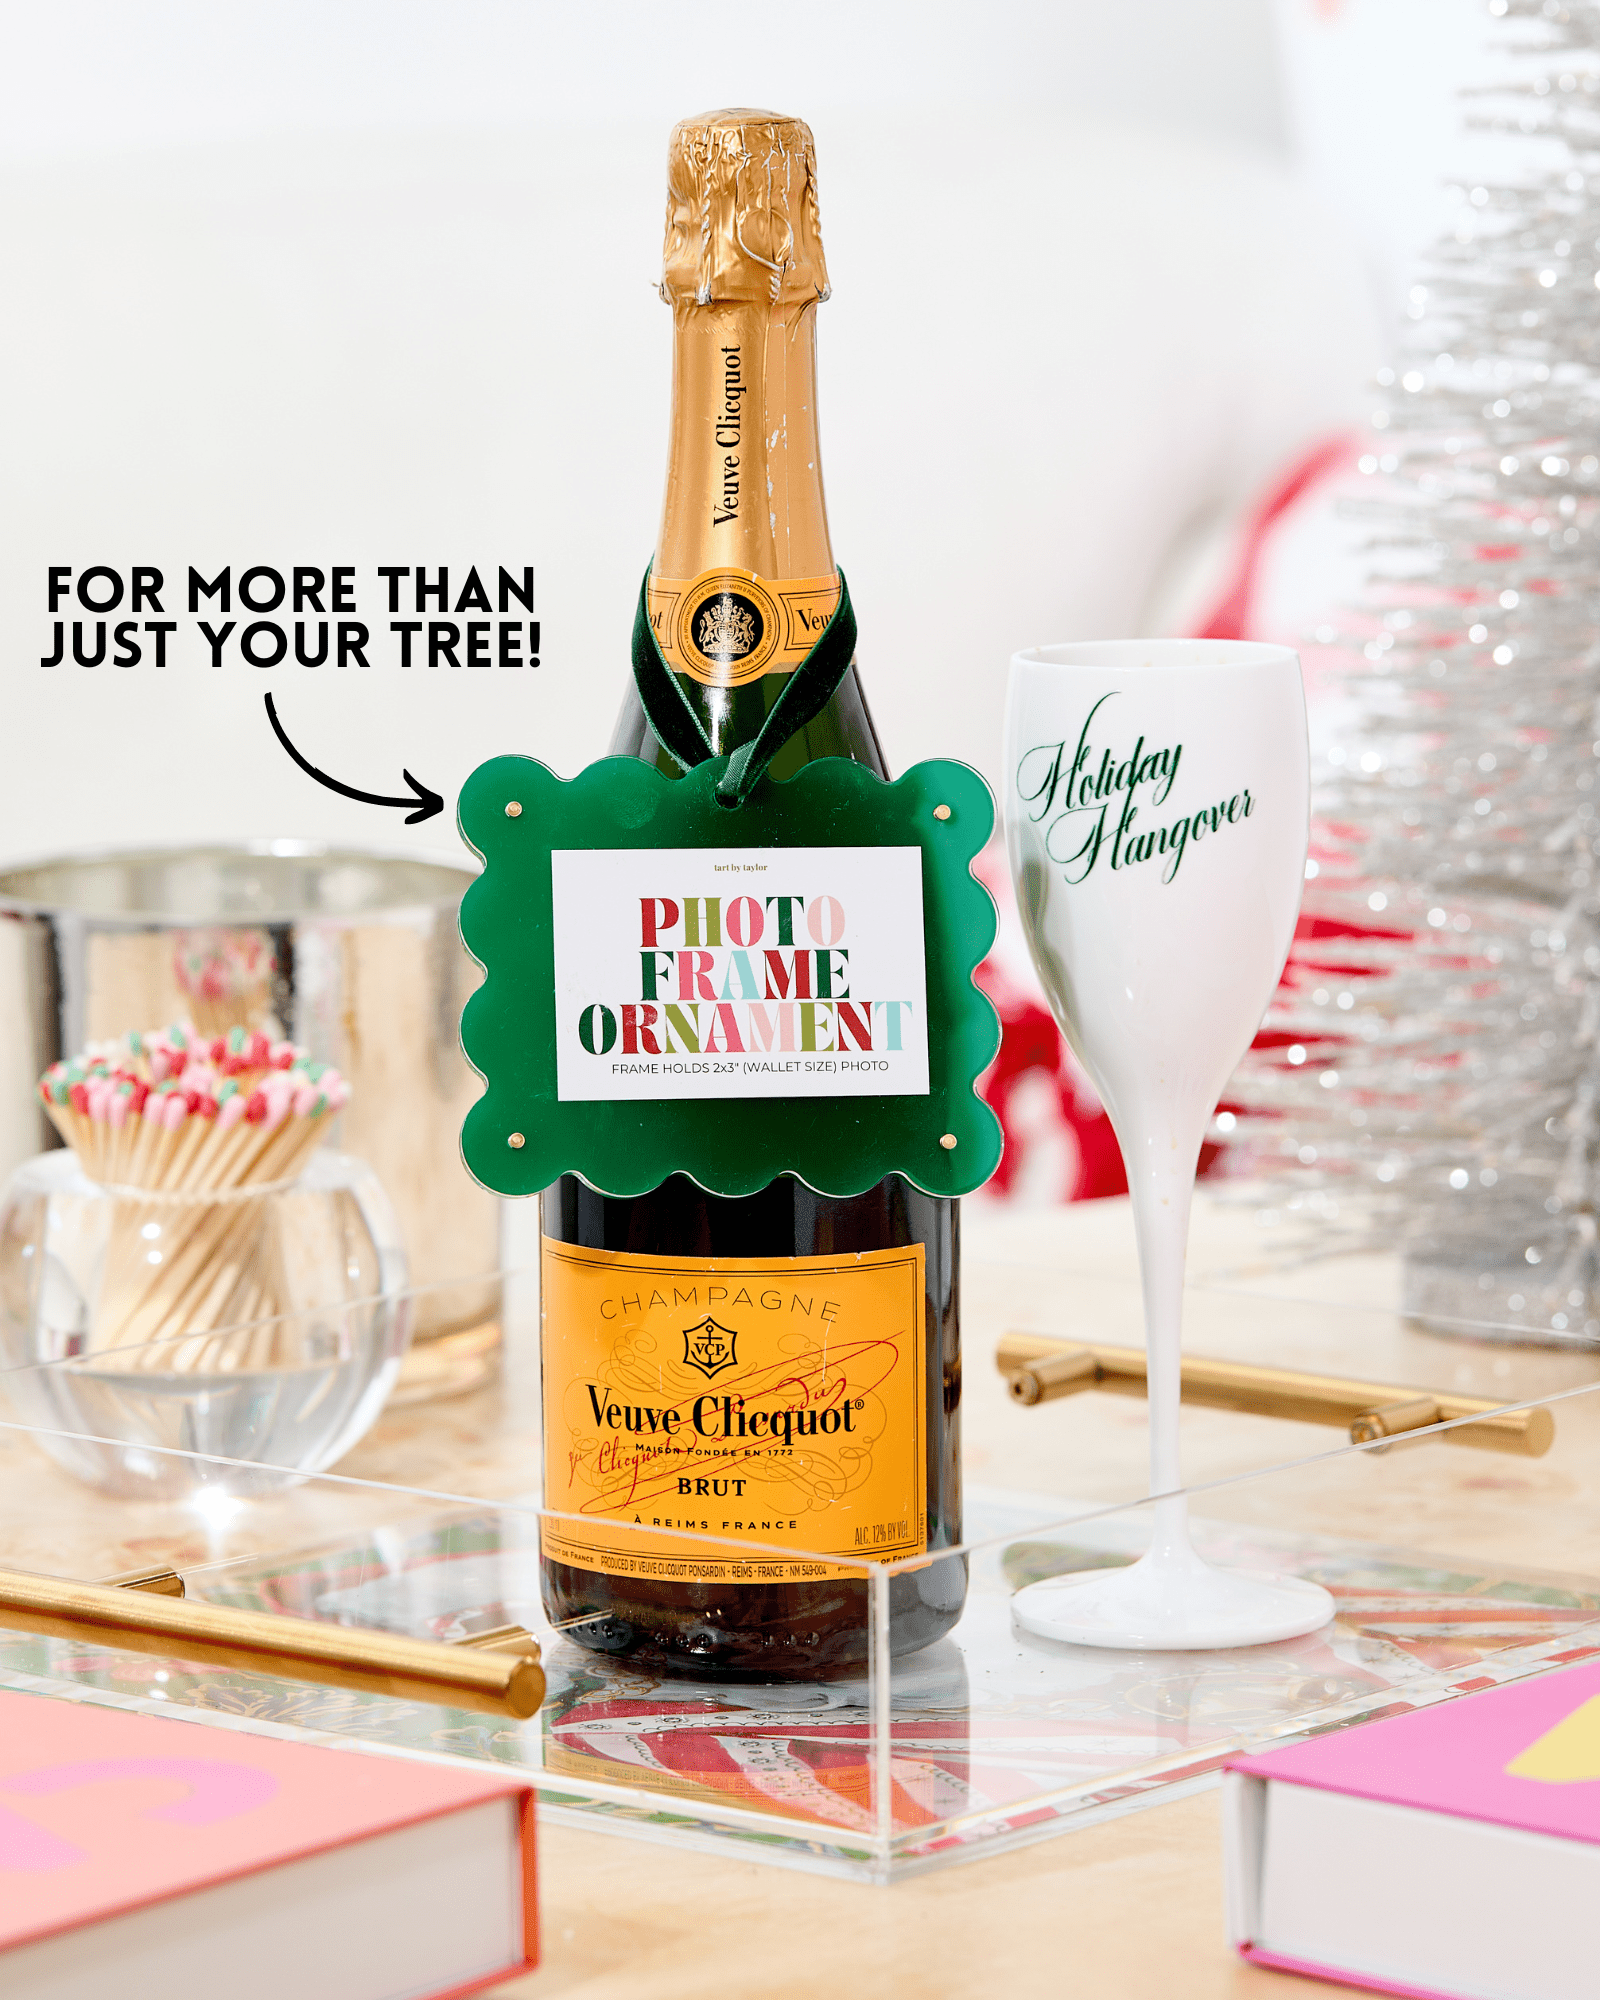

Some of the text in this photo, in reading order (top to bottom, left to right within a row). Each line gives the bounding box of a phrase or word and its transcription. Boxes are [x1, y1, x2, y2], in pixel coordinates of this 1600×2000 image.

[713, 344, 747, 528] Veuve Clicquot
[1016, 691, 1182, 822] Holiday
[1045, 767, 1255, 885] Hangover
[714, 863, 768, 873] tart by taylor
[639, 895, 846, 948] PHOTO
[639, 949, 850, 1001] FRAME
[578, 1001, 914, 1056] ORNAMENT
[612, 1063, 659, 1075] FRAME
[663, 1063, 710, 1075] HOLDS
[743, 1061, 801, 1075] (WALLET
[804, 1060, 837, 1074] SIZE)
[841, 1060, 889, 1072] PHOTO
[600, 1286, 841, 1324] CHAMPAGNE
[693, 1343, 726, 1357] VCP
[585, 1384, 681, 1435] Veuve
[744, 1448, 761, 1457] EN
[767, 1448, 794, 1457] 1772
[677, 1477, 747, 1497] BRUT
[653, 1517, 708, 1530] REIMS
[722, 1520, 798, 1530] FRANCE
[888, 1523, 898, 1541] BY
[601, 1555, 629, 1571] PRODUCED
[630, 1559, 637, 1572] BY
[638, 1560, 657, 1574] VEUVE
[688, 1565, 726, 1578] PONSARDIN
[732, 1566, 753, 1578] REIMS
[758, 1566, 784, 1577] FRANCE
[790, 1566, 800, 1576] NM
